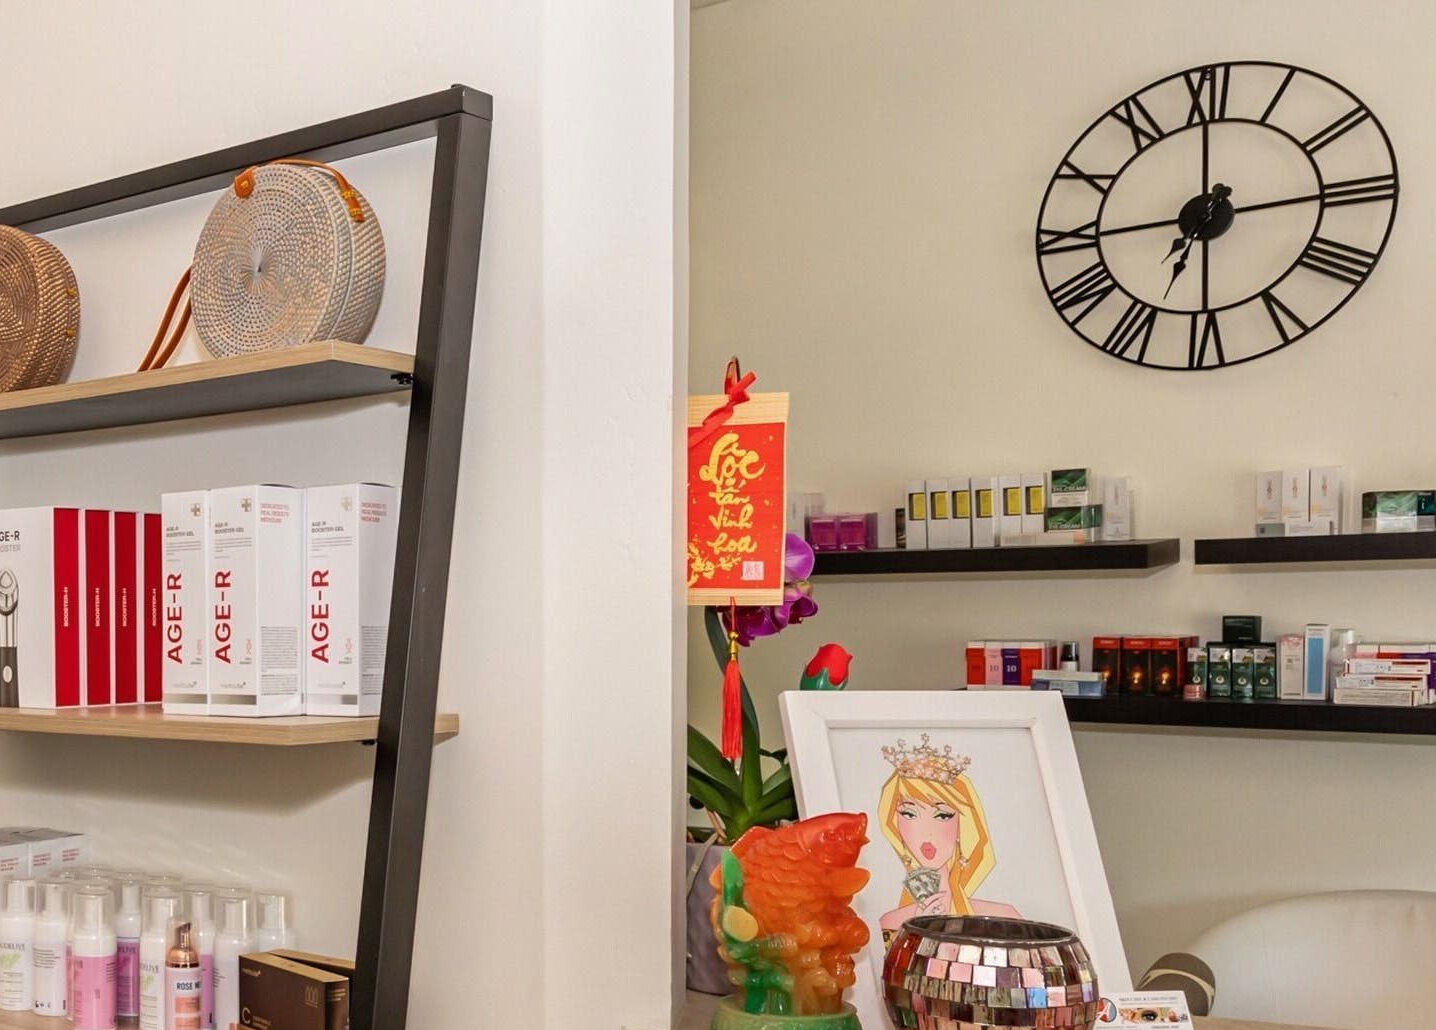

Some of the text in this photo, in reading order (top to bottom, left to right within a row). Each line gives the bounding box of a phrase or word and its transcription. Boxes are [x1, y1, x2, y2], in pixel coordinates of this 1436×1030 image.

[167, 572, 183, 664] AGE-R
[215, 570, 231, 663] AGE-R
[311, 569, 329, 663] AGE-R
[1006, 665, 1017, 673] 10
[177, 982, 193, 991] ROSE
